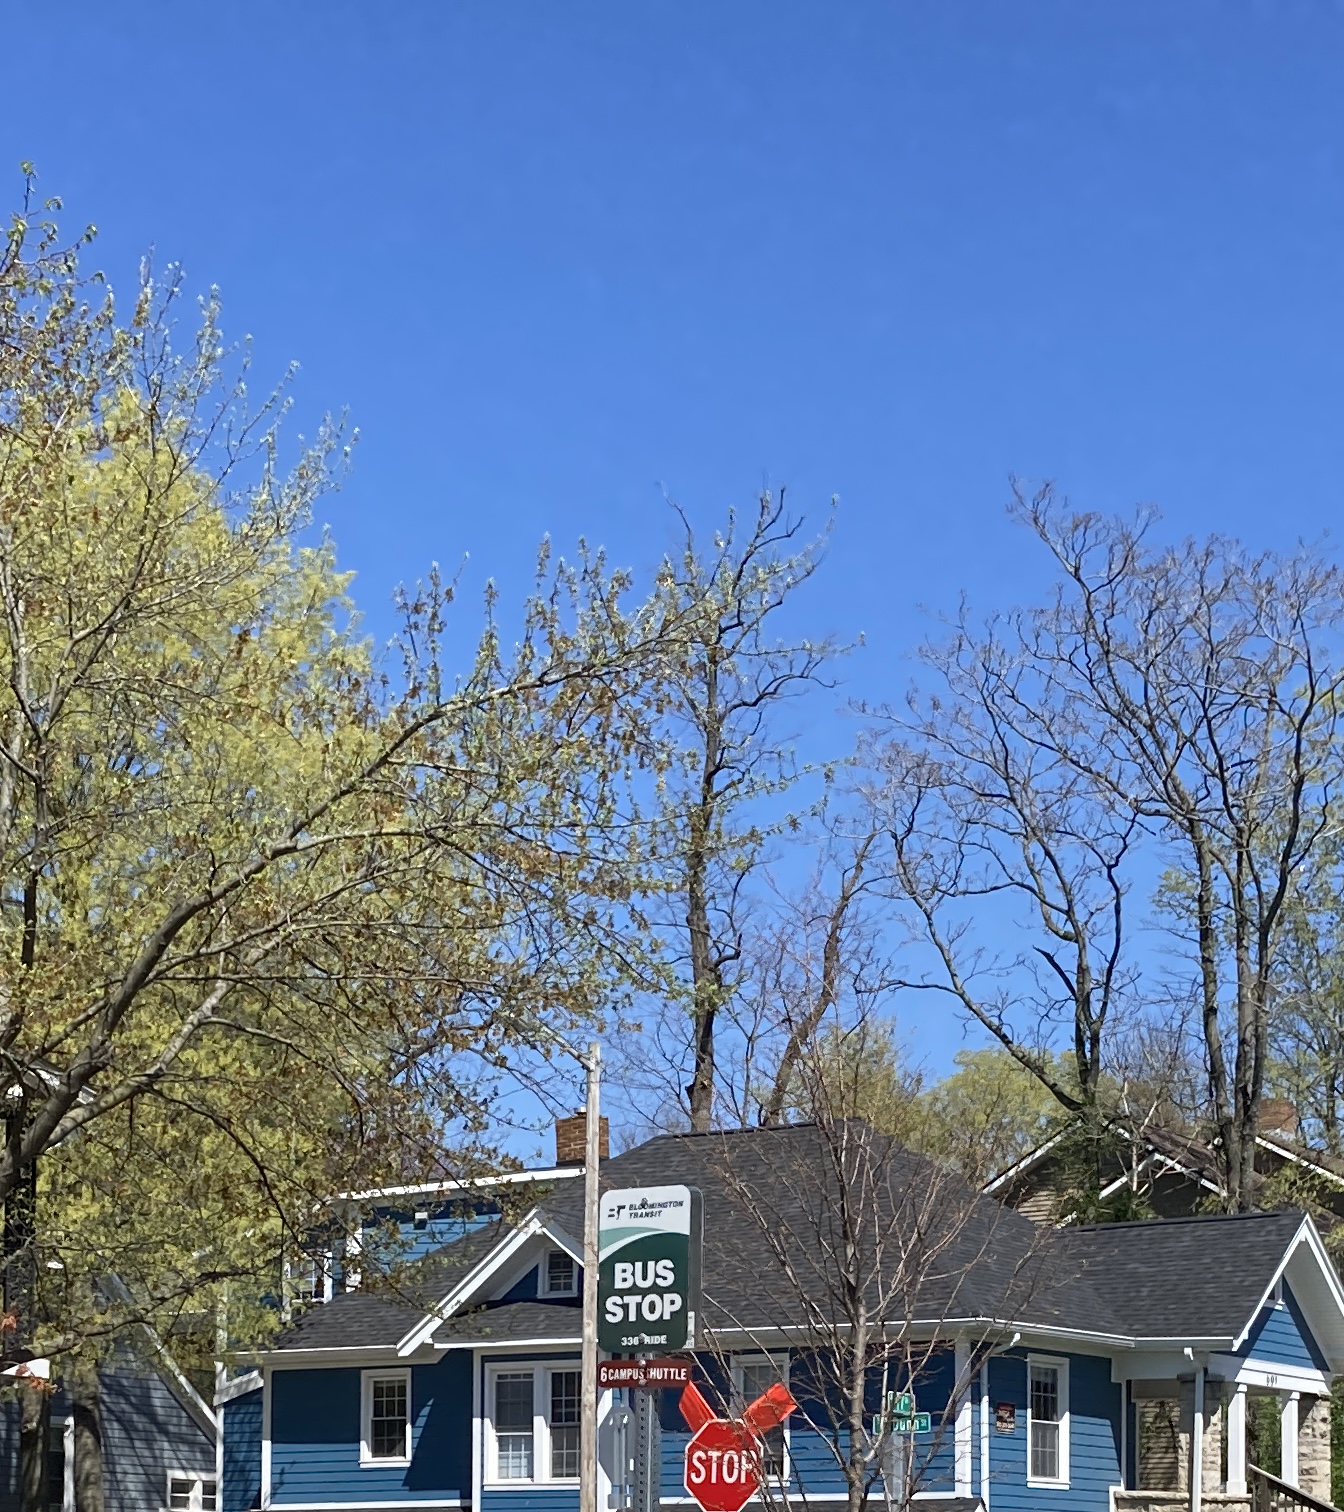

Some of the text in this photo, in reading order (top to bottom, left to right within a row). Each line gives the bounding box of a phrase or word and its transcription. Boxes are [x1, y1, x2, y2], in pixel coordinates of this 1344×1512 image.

[628, 1210, 663, 1220] TRANSIT
[614, 1259, 675, 1289] BUS
[605, 1292, 683, 1324] STOP
[600, 1366, 608, 1383] 6
[608, 1368, 644, 1380] CAMPUS
[690, 1450, 758, 1484] STOP
